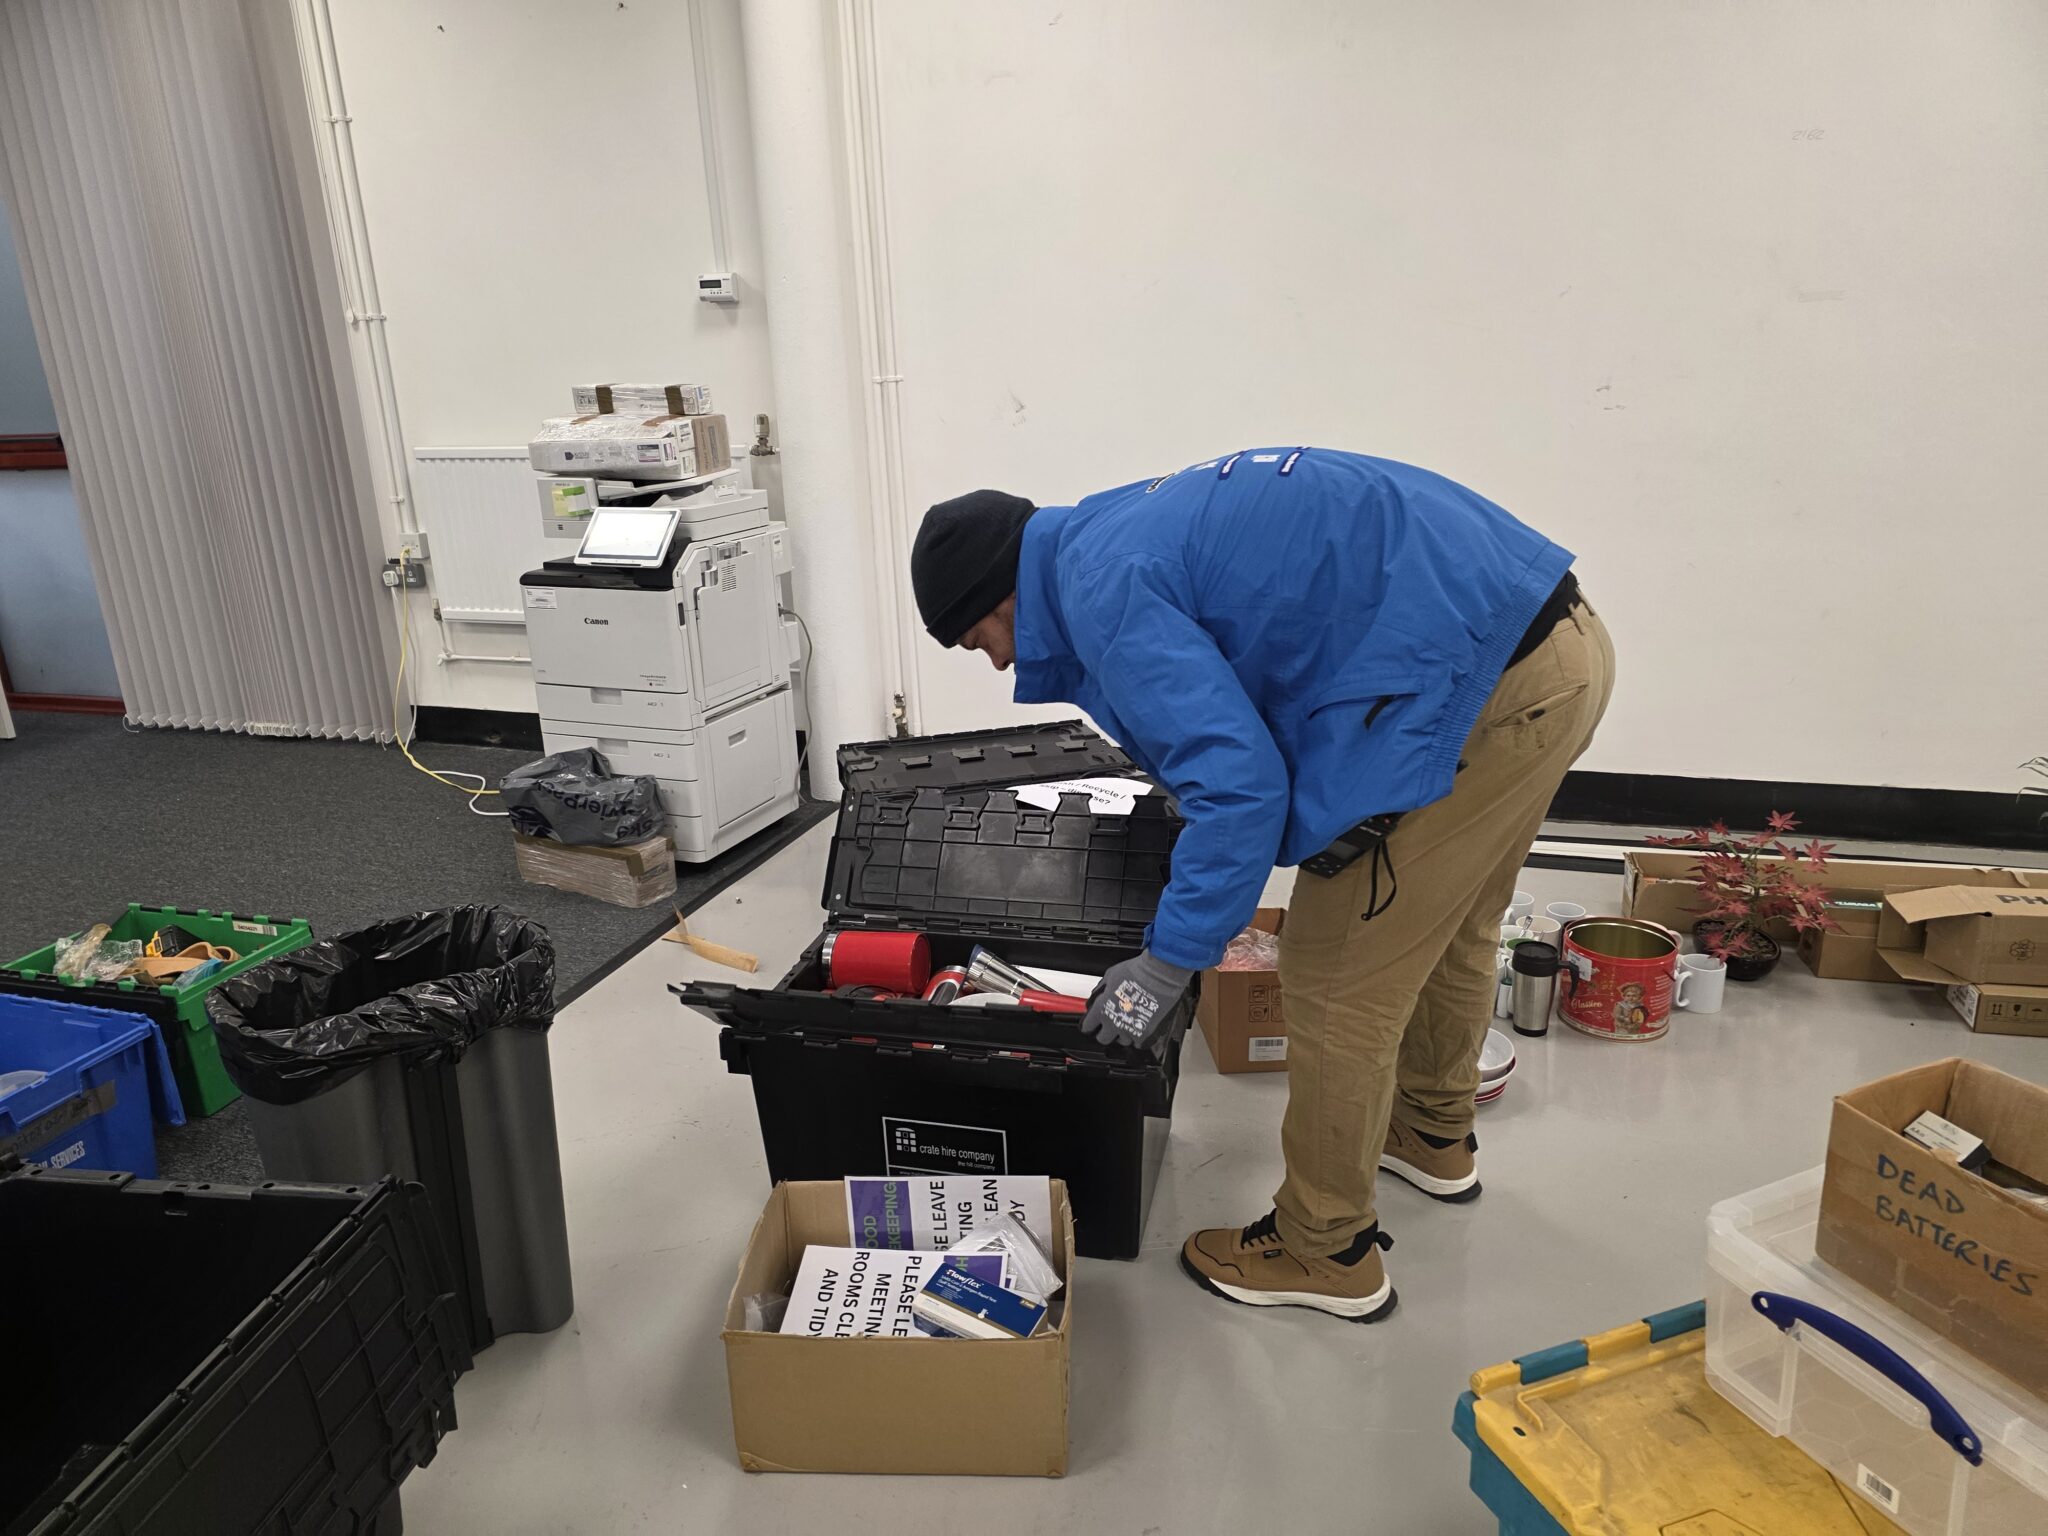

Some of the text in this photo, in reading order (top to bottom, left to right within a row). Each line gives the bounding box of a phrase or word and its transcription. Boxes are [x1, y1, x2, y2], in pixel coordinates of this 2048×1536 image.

[584, 617, 609, 626] Canon
[1082, 784, 1119, 797] Recycle
[617, 818, 653, 838] 5kg
[51, 1140, 85, 1168] SERVICES
[920, 1145, 995, 1163] crate hire company
[1877, 1153, 1965, 1214] DEAD
[884, 1181, 901, 1249] EKEEPING
[930, 1180, 947, 1232] LEAVE
[958, 1201, 973, 1240] TING
[864, 1215, 878, 1248] OOD
[1876, 1195, 2039, 1297] BATTERIES
[817, 1268, 839, 1302] AND
[843, 1251, 870, 1308] ROOMS
[896, 1256, 922, 1314] PLEASE
[946, 1269, 981, 1289] Flowflex
[864, 1273, 892, 1338] MEETIN
